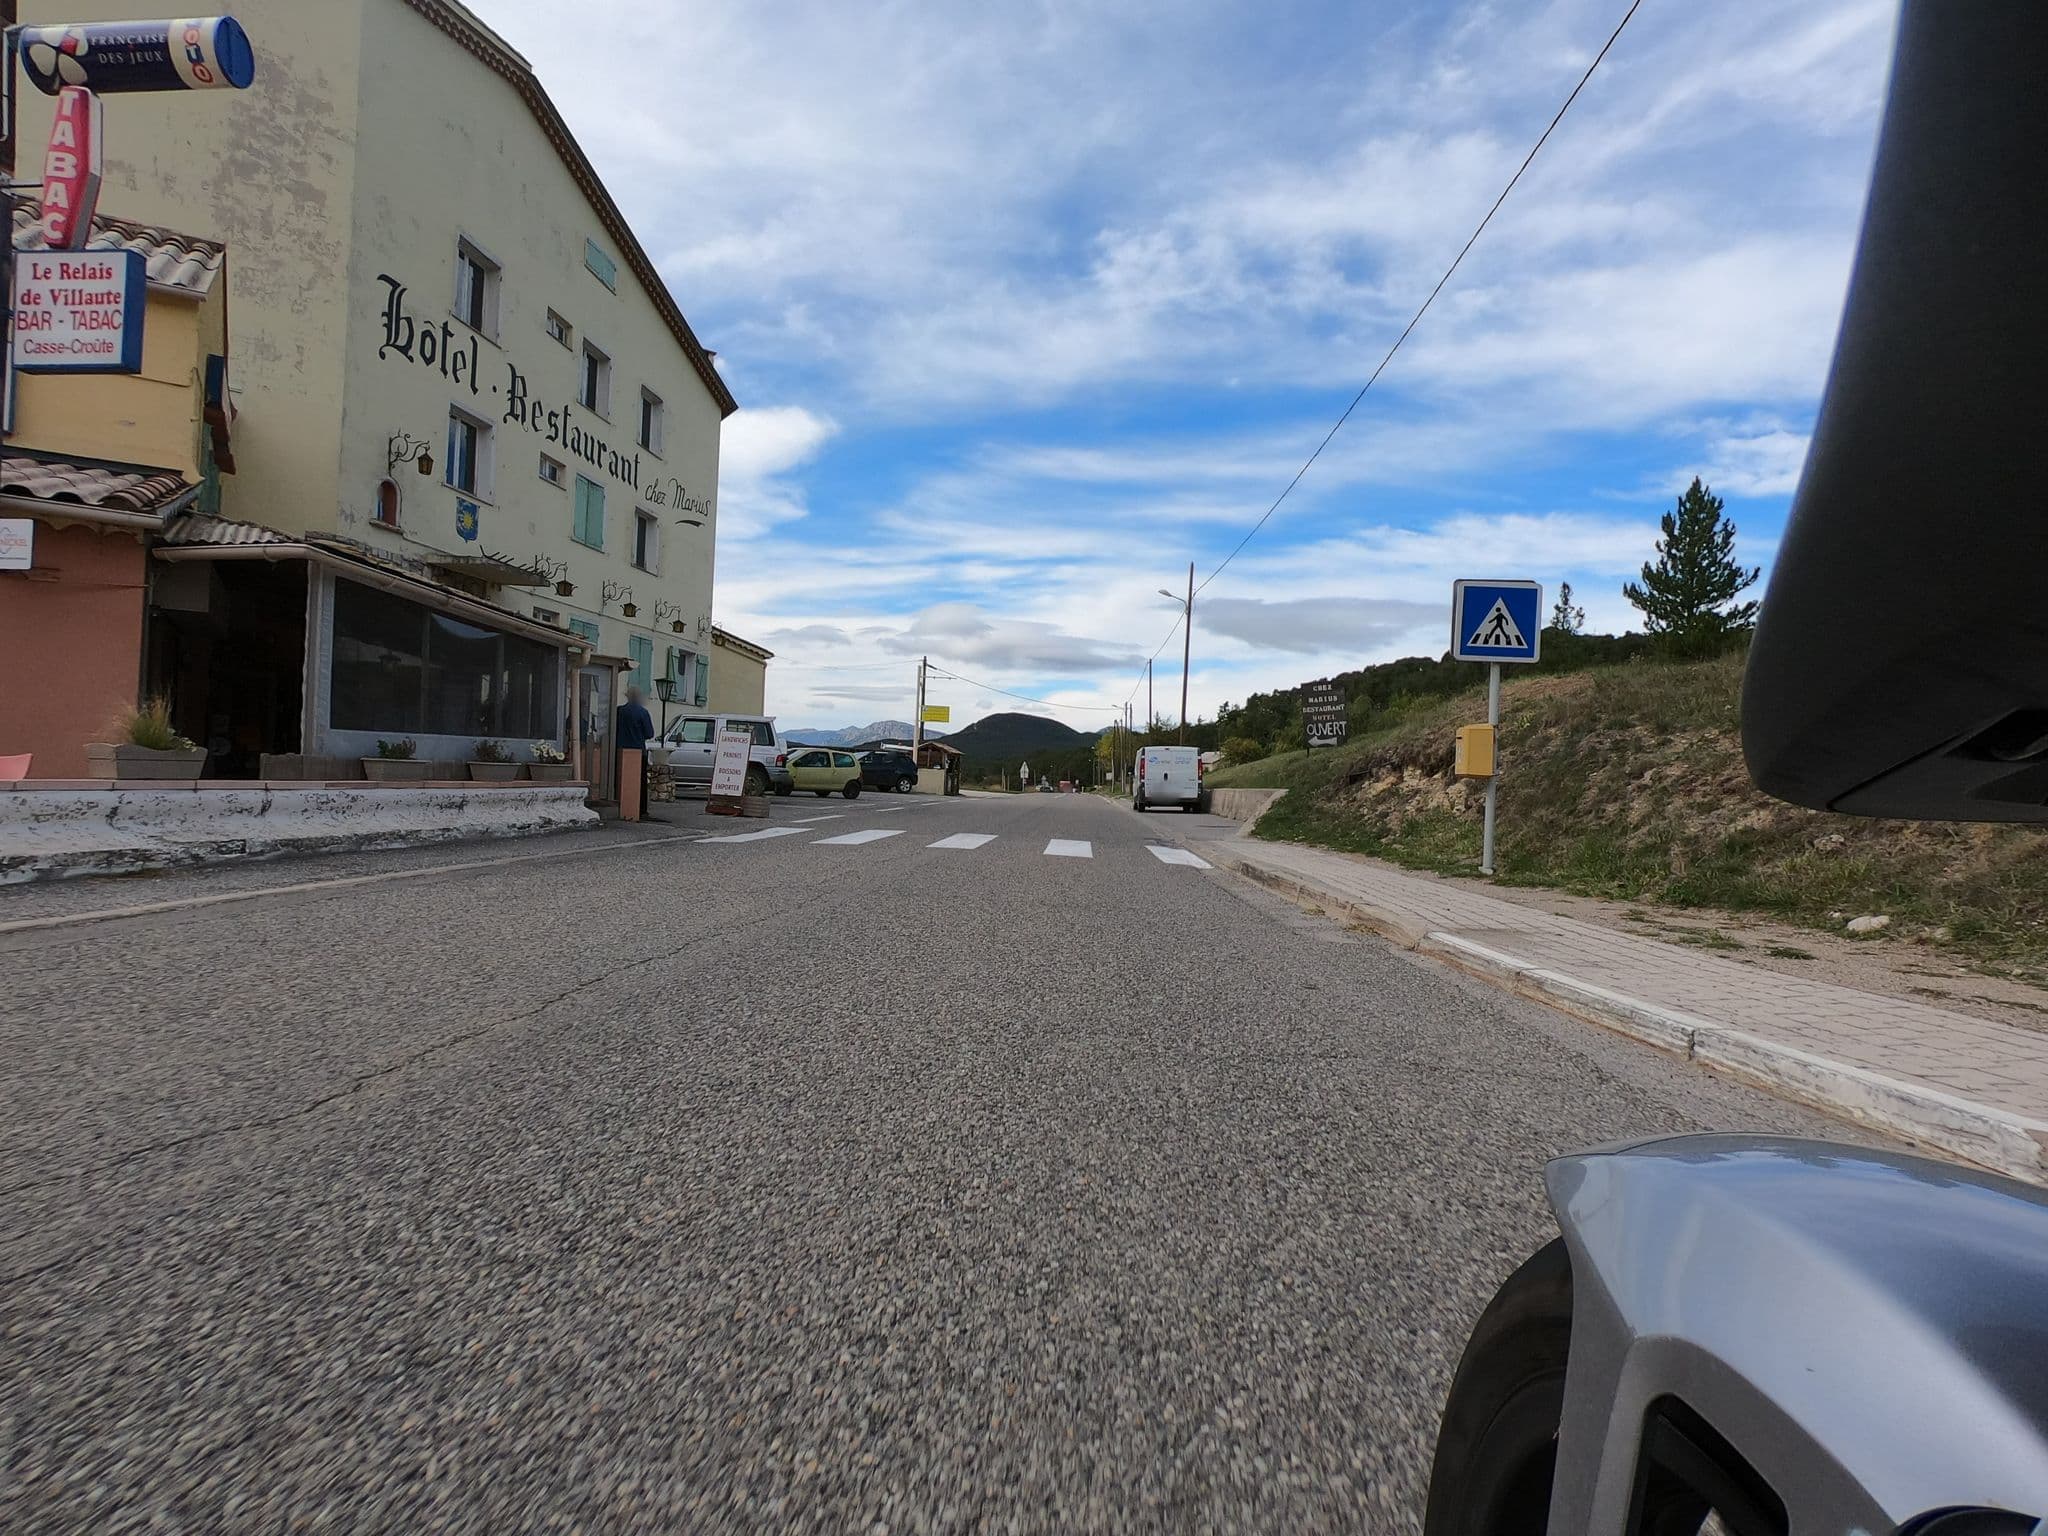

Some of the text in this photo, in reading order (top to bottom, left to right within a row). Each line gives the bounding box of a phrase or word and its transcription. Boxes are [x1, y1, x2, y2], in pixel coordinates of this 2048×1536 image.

[98, 50, 164, 65] DES JEUX
[42, 90, 79, 240] TABAC
[31, 262, 113, 281] Le Relais
[20, 288, 122, 307] de Villaute
[16, 310, 53, 332] BAR
[69, 309, 123, 332] TABAC
[23, 338, 115, 355] Casse-Croûte
[502, 362, 641, 492] Restaurant
[667, 477, 712, 517] Marius
[1306, 720, 1348, 737] OUVERT
